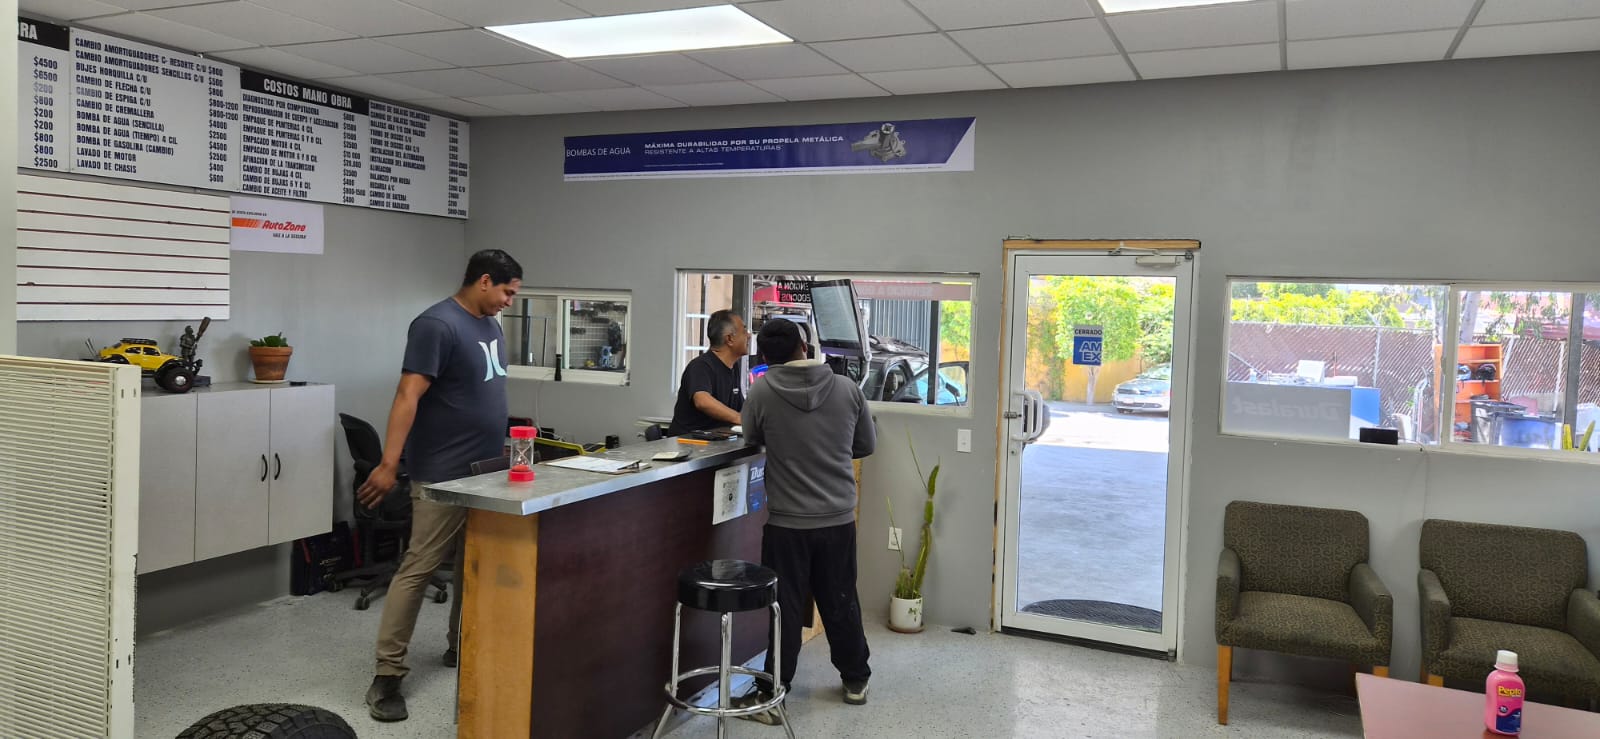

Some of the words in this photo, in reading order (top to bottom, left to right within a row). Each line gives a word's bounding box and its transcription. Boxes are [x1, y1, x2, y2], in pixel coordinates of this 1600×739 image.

[20, 22, 38, 40] RA
[75, 38, 102, 51] CAMBIO
[105, 44, 159, 63] AMORTIGUADORES
[170, 58, 194, 70] RESORTE
[34, 56, 58, 70] $4500
[75, 50, 102, 63] CAMBIO
[105, 56, 159, 74] AMORTIGUADORES
[162, 68, 192, 81] SENCILLOS
[34, 69, 58, 82] $6500
[76, 62, 97, 74] BUJES
[100, 67, 134, 81] HORQUILLA
[34, 82, 54, 94] $200
[76, 74, 102, 86] CAMBIO
[105, 80, 112, 88] DE
[115, 81, 138, 93] FLECHA
[76, 86, 102, 98] CAMBIO
[105, 91, 112, 100] DE
[115, 93, 137, 104] ESPIGA
[264, 78, 299, 97] COSTOS
[303, 88, 327, 104] MANO
[331, 94, 352, 109] OBRA
[34, 95, 54, 107] $800
[34, 107, 54, 119] $200
[76, 99, 102, 110] CAMBIO
[105, 103, 112, 112] DE
[116, 105, 155, 119] CREMALLERA
[34, 120, 54, 131] $200
[76, 111, 100, 122] BOMBA
[103, 115, 110, 123] DE
[114, 116, 130, 126] AGUA
[132, 119, 165, 132] (SENCILLA)
[34, 132, 54, 143] $800
[76, 123, 100, 134] BOMBA
[103, 127, 110, 135] DE
[114, 128, 130, 138] AGUA
[132, 131, 160, 142] (TIEMPO)
[34, 144, 54, 155] $800
[77, 135, 100, 146] BOMBA
[103, 138, 111, 147] DE
[114, 140, 143, 151] GASOLINA
[146, 144, 174, 155] (CAMBIO)
[77, 147, 101, 158] LAVADO
[104, 150, 111, 159] DE
[114, 152, 137, 162] MOTOR
[566, 149, 596, 157] BOMBAS
[34, 157, 58, 168] $2500
[77, 159, 101, 170] LAVADO
[104, 162, 111, 171] DE
[115, 163, 137, 173] CHASIS
[262, 220, 306, 231] AutoZone
[1080, 341, 1102, 352] AM
[1083, 351, 1102, 361] EX
[1498, 686, 1521, 697] Pepto
